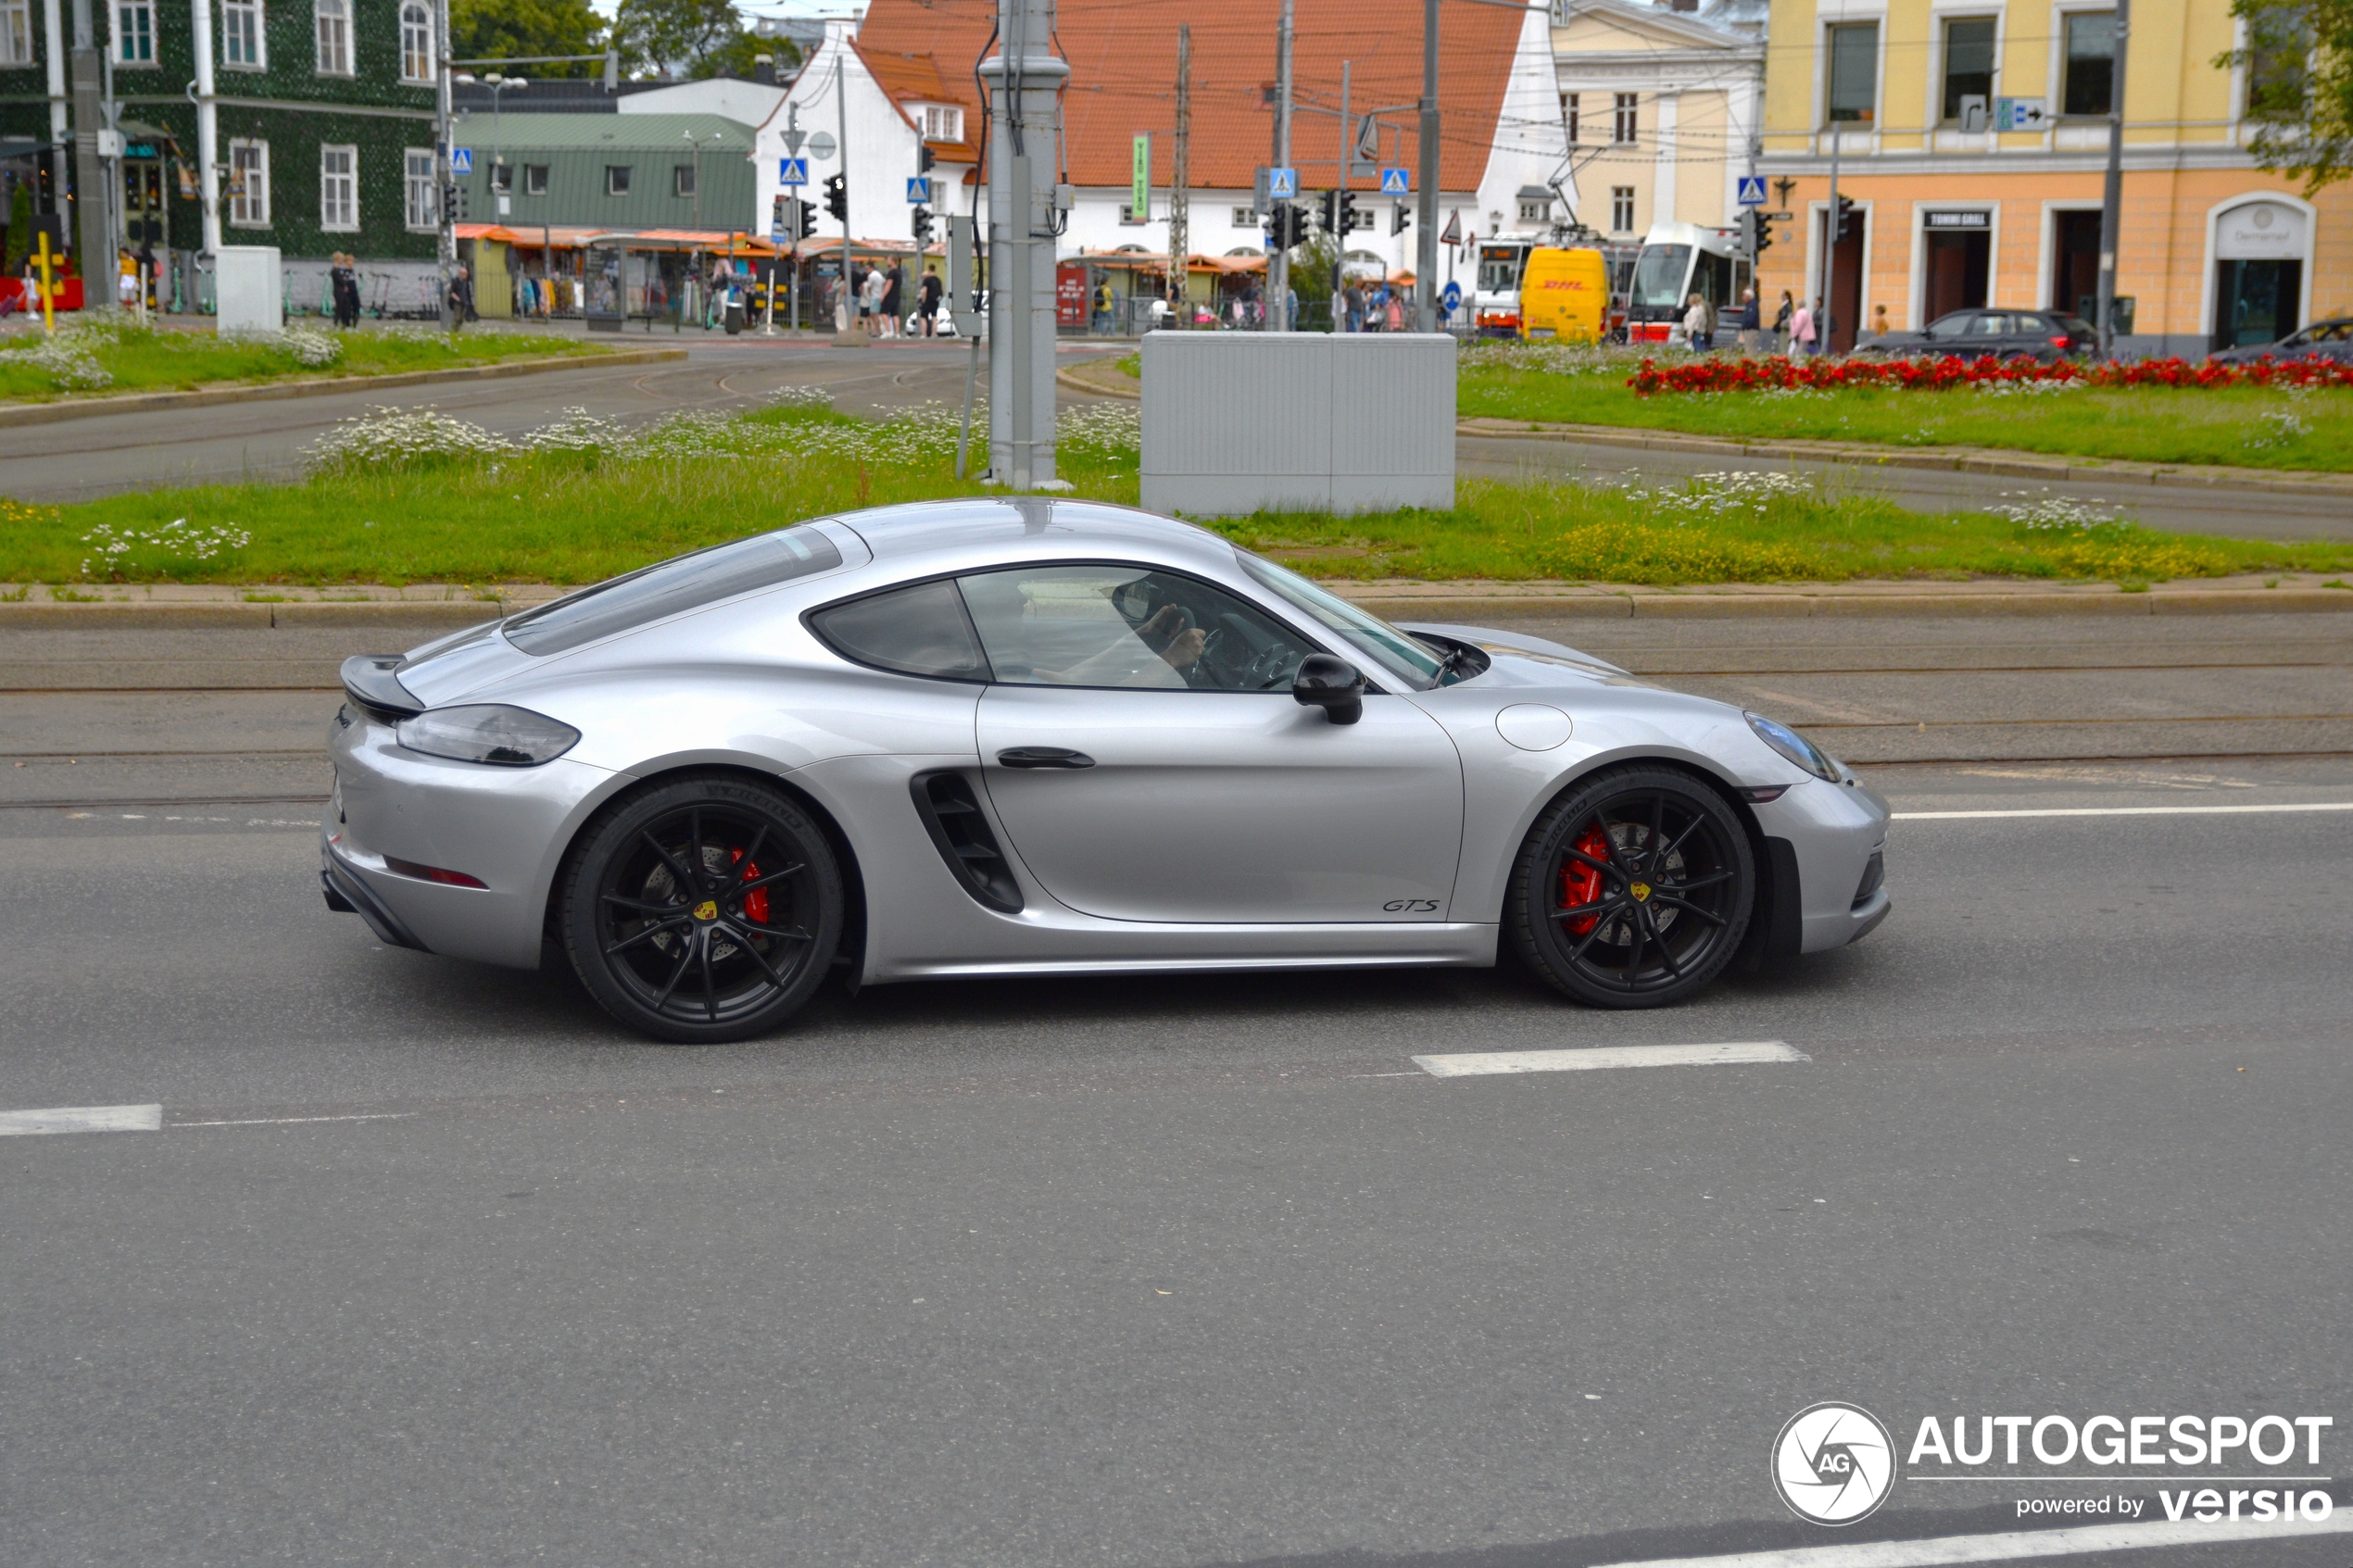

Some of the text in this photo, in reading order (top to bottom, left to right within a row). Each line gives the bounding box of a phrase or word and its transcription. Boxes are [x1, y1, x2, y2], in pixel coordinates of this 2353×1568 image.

[1961, 213, 1985, 226] GRILL
[1543, 280, 1583, 291] DHL
[730, 786, 801, 830] MICHELIN
[1546, 797, 1588, 847] MICHELIN
[1382, 899, 1441, 912] GTS
